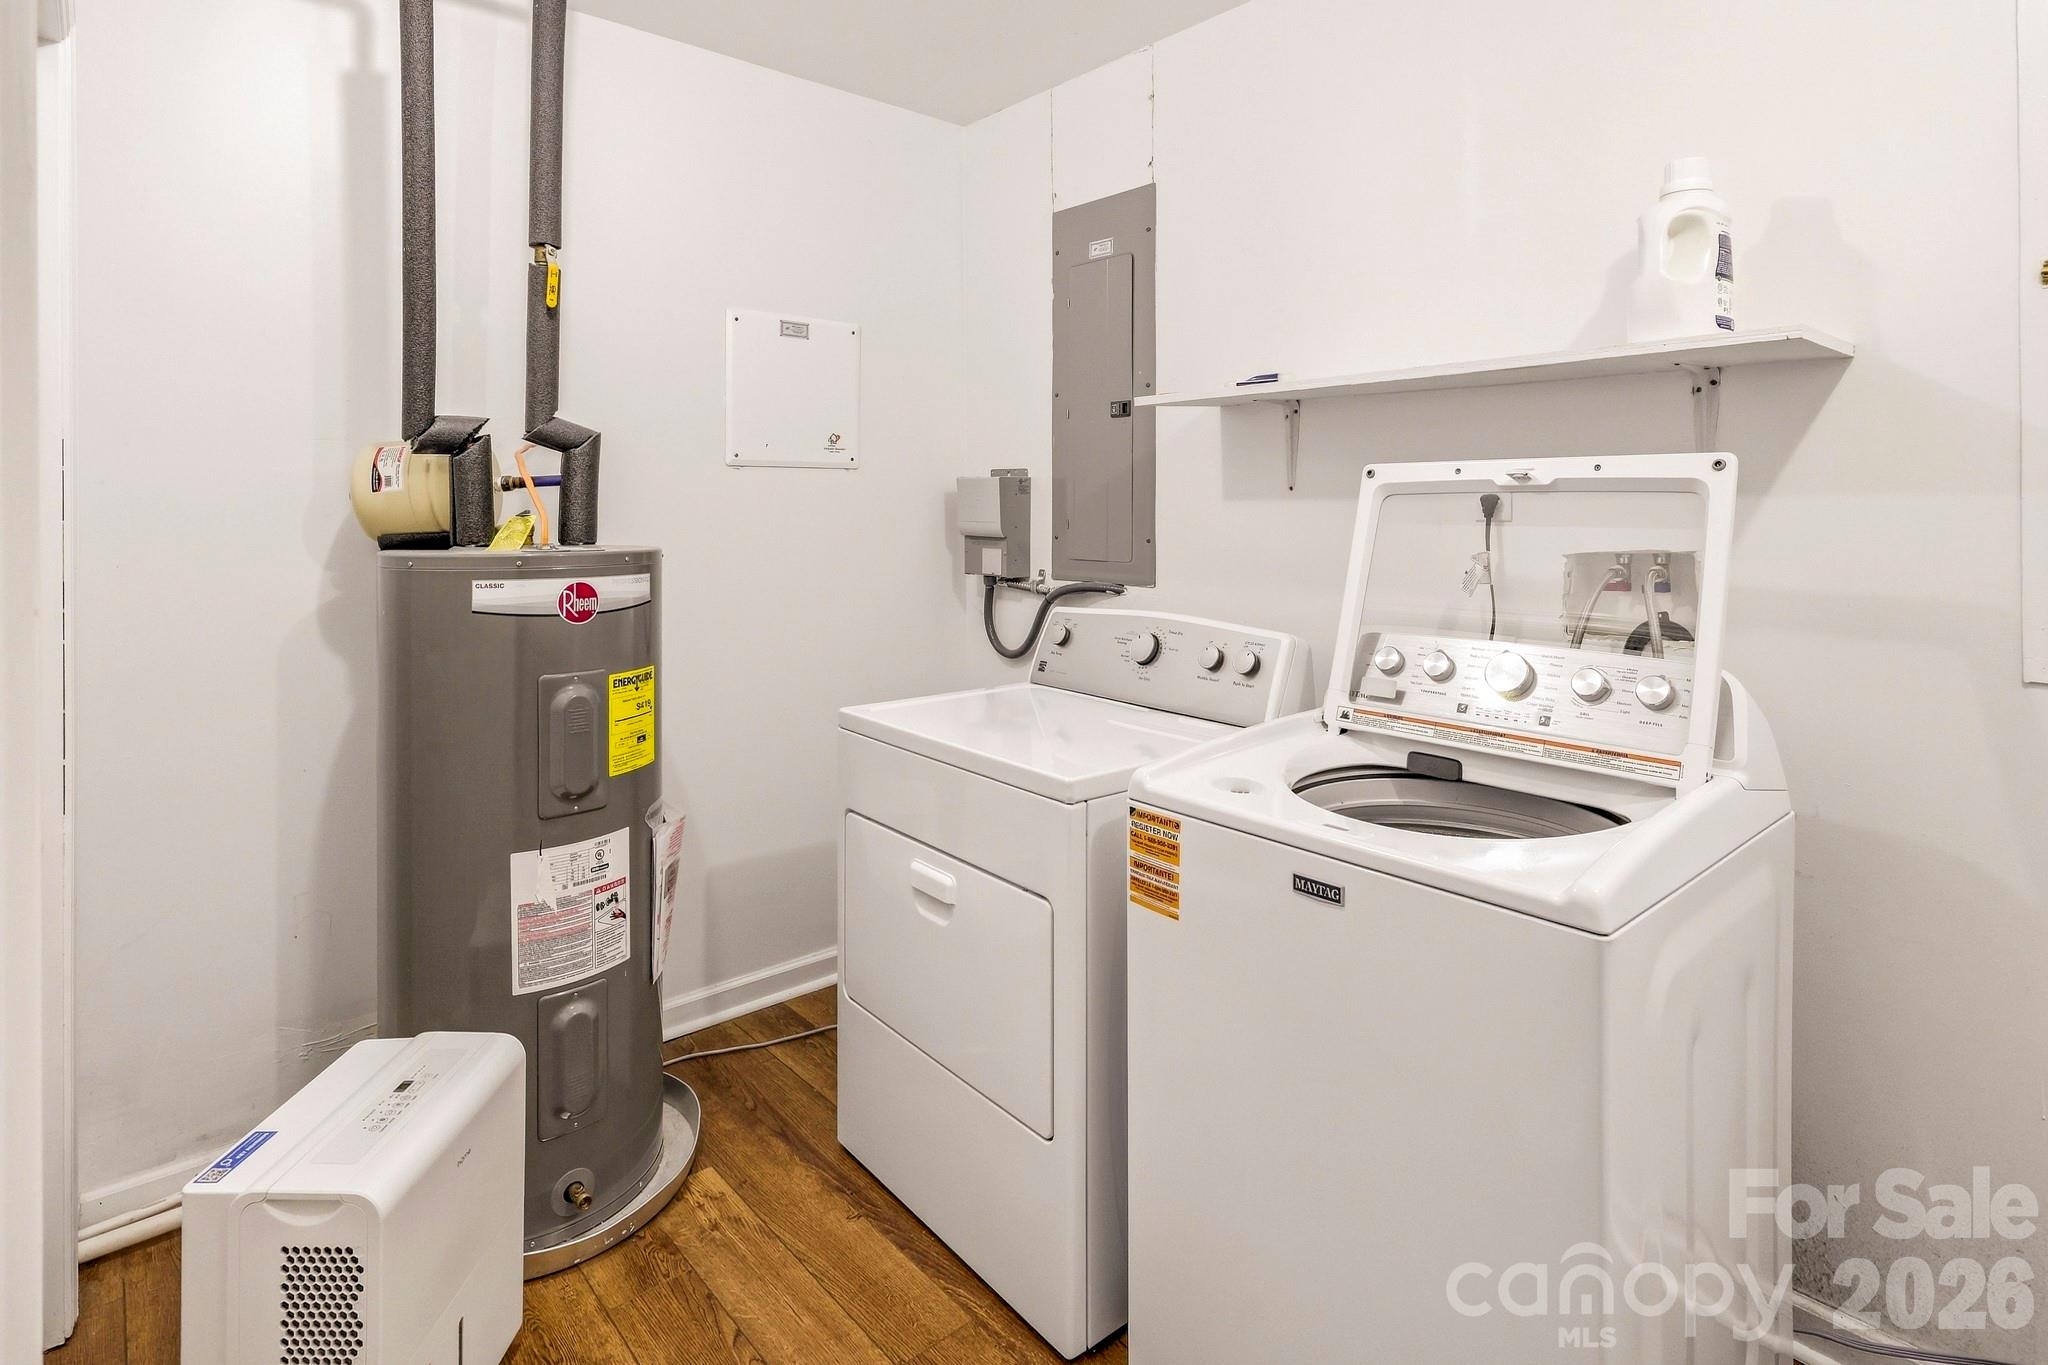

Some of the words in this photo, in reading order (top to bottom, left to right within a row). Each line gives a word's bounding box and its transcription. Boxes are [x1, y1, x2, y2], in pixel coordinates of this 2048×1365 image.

[562, 583, 598, 618] Rheem
[1131, 820, 1161, 836] REGISTER
[1162, 830, 1179, 841] NOW
[1295, 878, 1339, 900] MAYTAG
